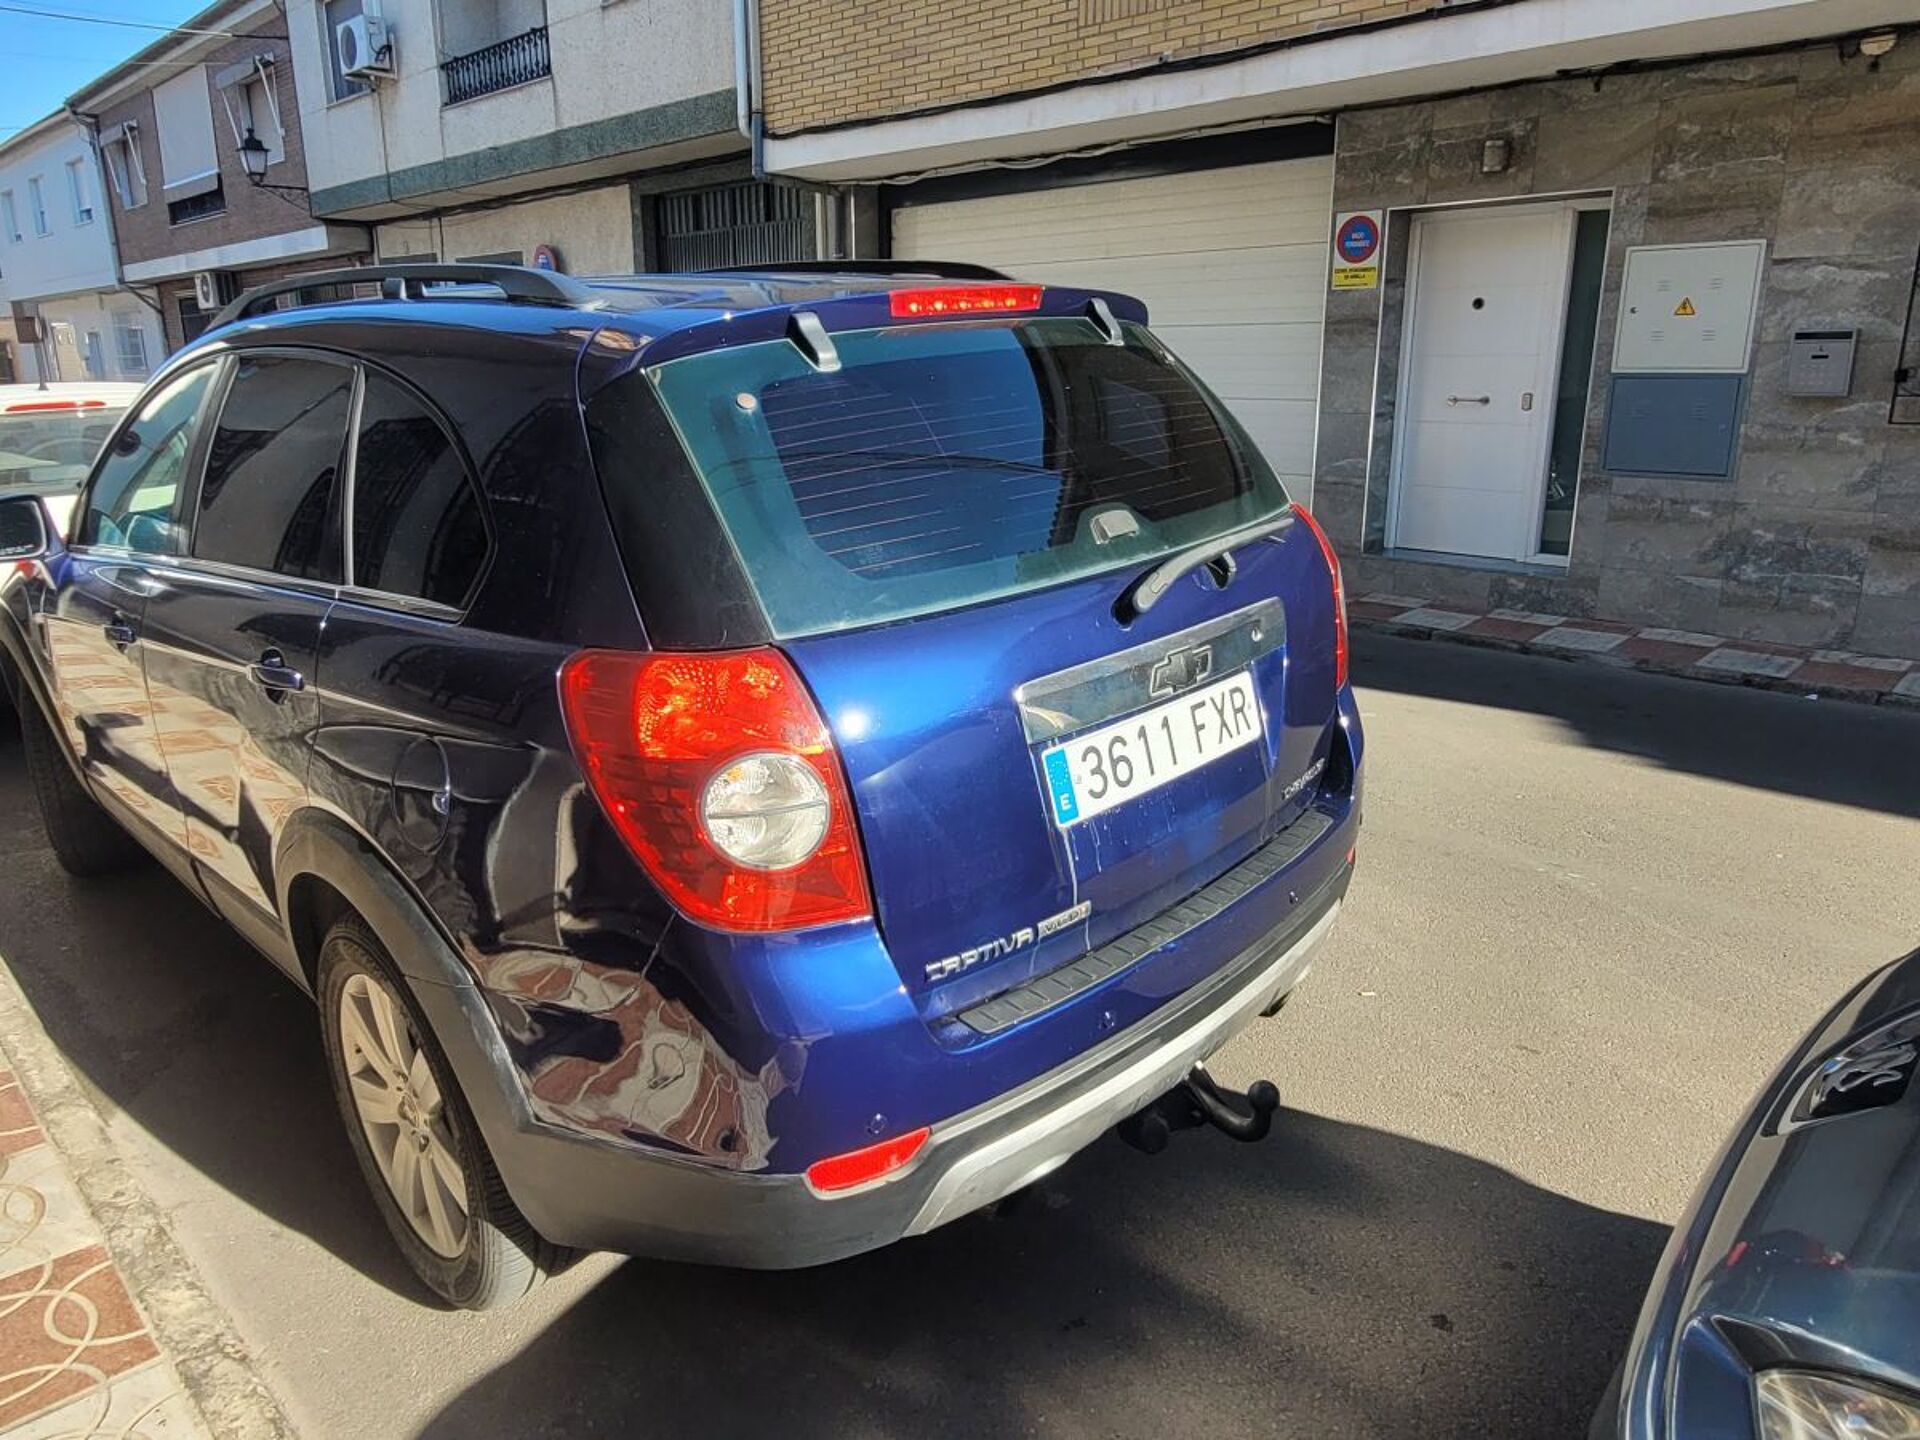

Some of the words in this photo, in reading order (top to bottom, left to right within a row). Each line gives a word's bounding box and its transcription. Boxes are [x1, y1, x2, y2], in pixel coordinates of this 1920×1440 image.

[1081, 715, 1178, 799] 3611
[1190, 686, 1251, 754] FXR
[1060, 793, 1072, 811] E
[926, 927, 1034, 981] CAPTIVA
